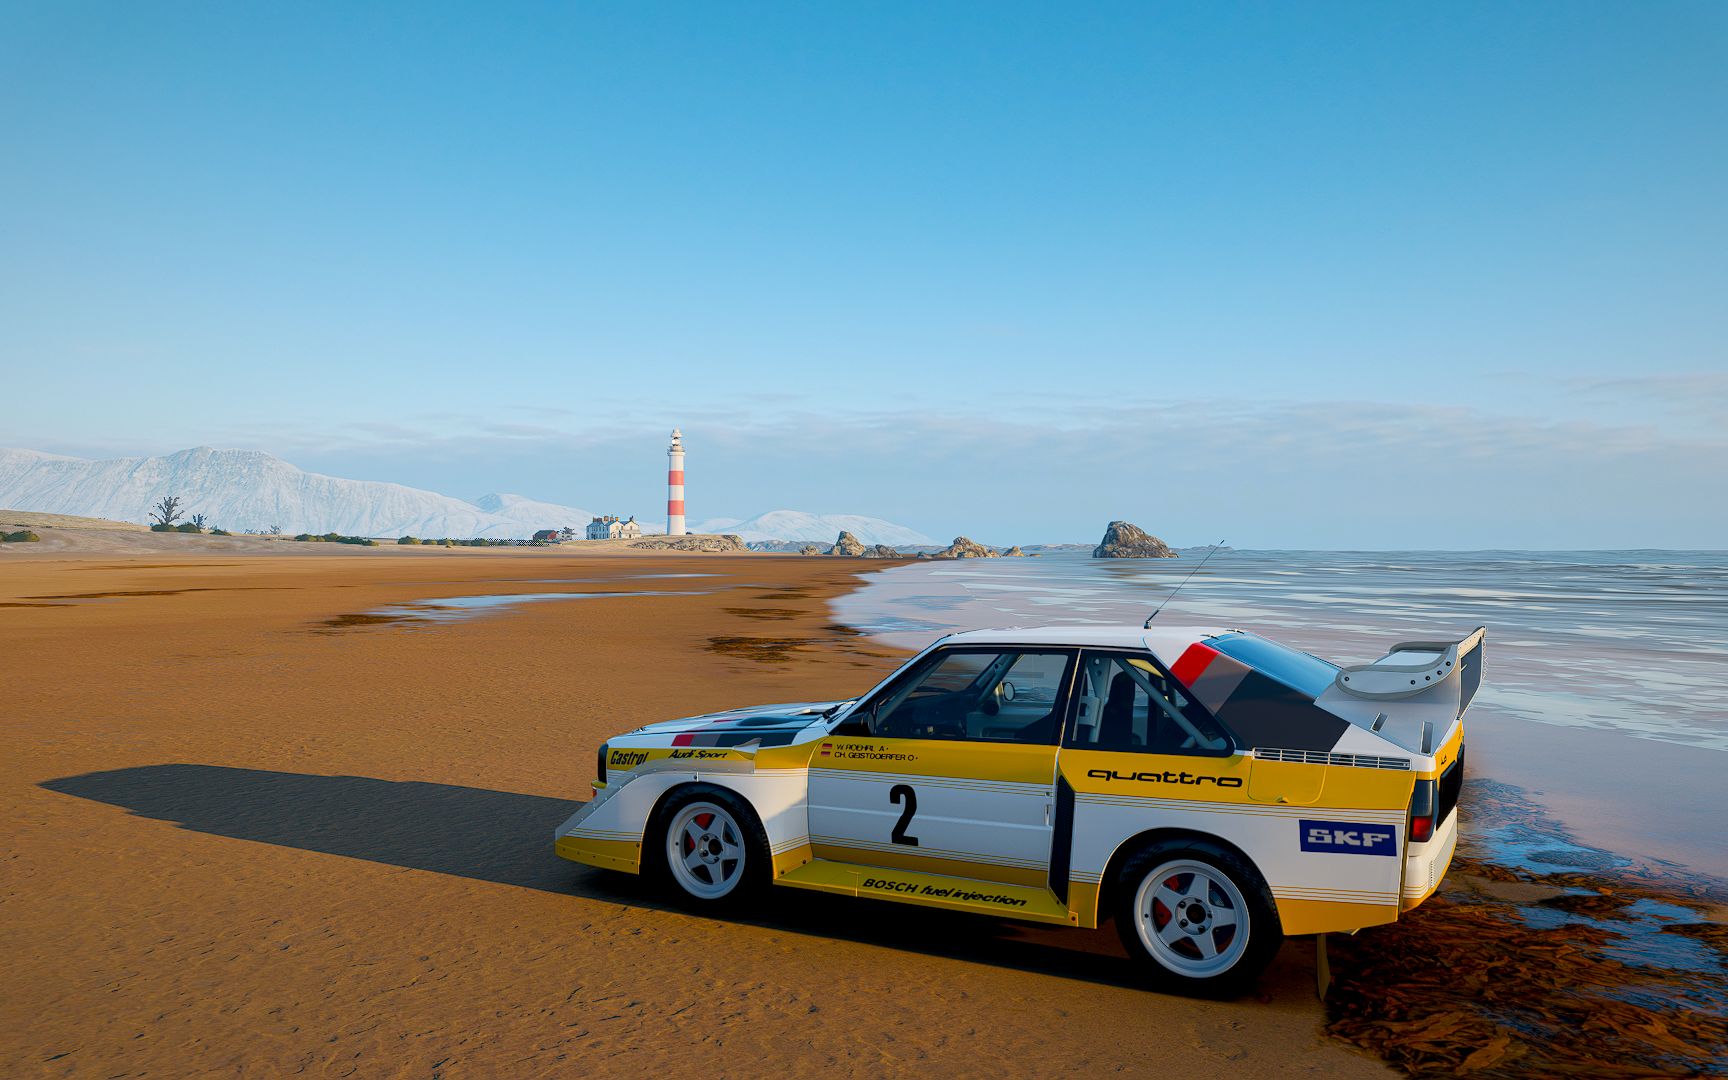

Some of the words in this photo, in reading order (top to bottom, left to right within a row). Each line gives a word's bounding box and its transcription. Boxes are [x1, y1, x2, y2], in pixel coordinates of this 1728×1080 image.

[610, 750, 649, 766] Castrol
[668, 749, 695, 759] Audi
[695, 750, 727, 759] Sport
[1087, 769, 1243, 788] quattro
[889, 784, 919, 847] 2
[1307, 828, 1390, 847] SKF
[862, 878, 919, 893] BOSCH
[919, 885, 955, 898] fuel
[952, 890, 1028, 907] injection
